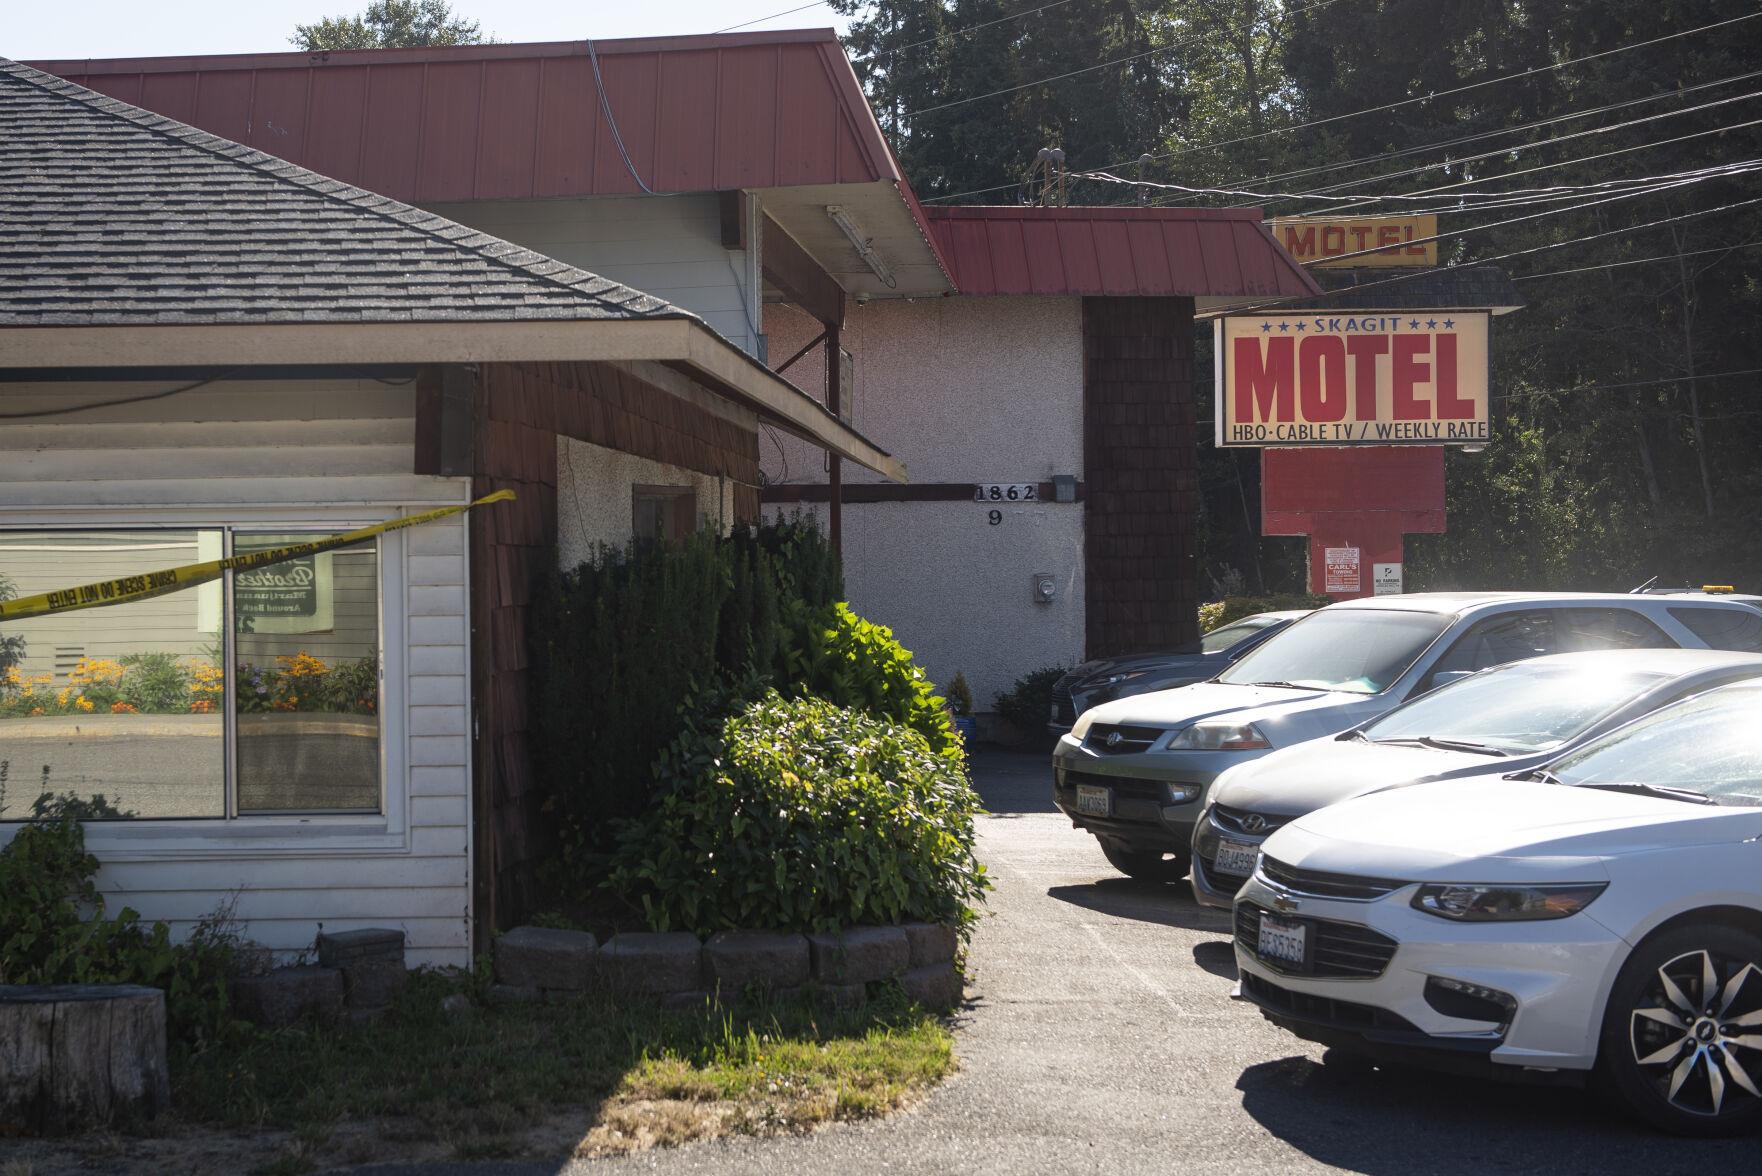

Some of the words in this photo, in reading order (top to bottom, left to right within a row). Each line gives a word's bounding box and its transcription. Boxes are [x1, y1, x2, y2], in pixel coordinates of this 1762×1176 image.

[1285, 225, 1427, 257] MOTEL
[1314, 317, 1402, 333] SKAGIT
[1233, 333, 1476, 424] MOTEL
[1332, 423, 1354, 440] TV
[1375, 422, 1441, 439] WEEKLY
[1447, 421, 1487, 438] RATE
[976, 485, 1034, 501] 1862
[988, 509, 1003, 526] 9
[115, 576, 145, 596] SCENE
[147, 570, 177, 590] CRIME
[46, 589, 76, 610] ENTER
[80, 585, 99, 604] NOT
[100, 581, 114, 599] DO
